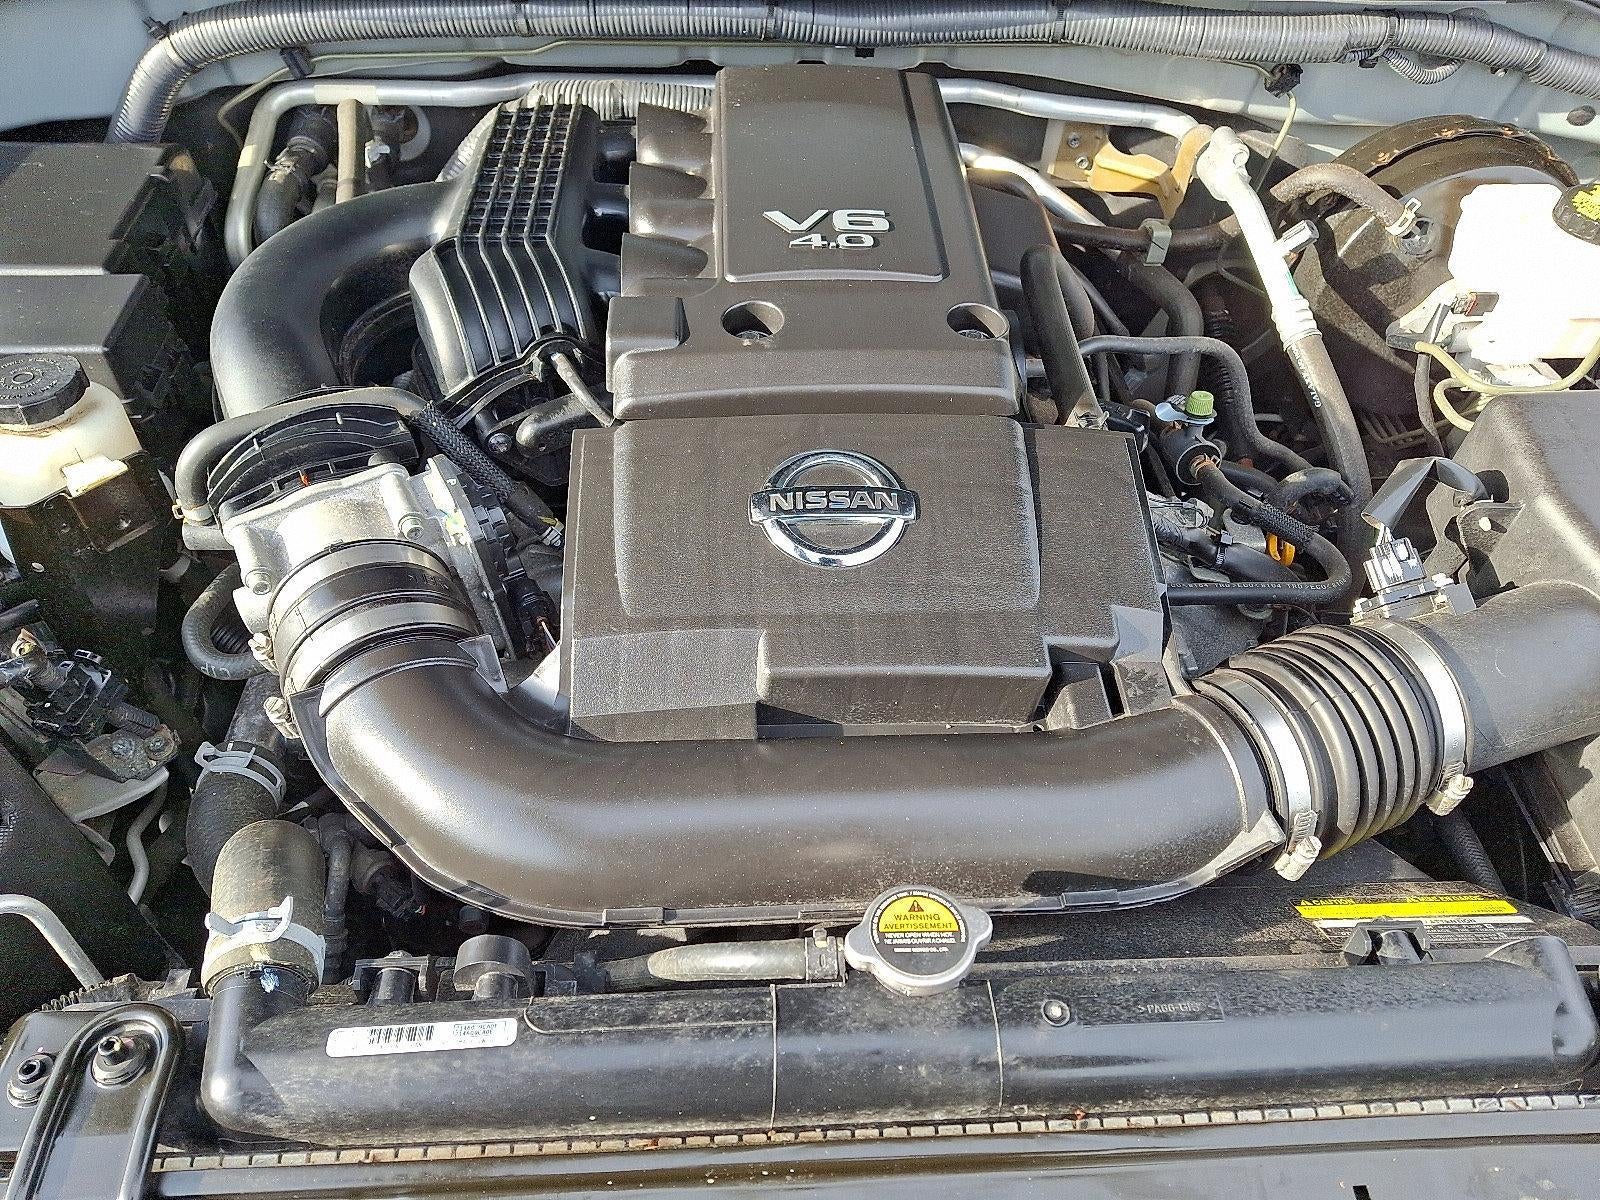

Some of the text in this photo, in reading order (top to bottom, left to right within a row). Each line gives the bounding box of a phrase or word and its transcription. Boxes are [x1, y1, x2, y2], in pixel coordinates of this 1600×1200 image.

[762, 208, 891, 234] V6
[788, 232, 875, 250] 4.0
[769, 490, 899, 512] NISSAN
[1312, 898, 1356, 906] CAUTION
[893, 913, 940, 921] WARNING
[884, 922, 953, 930] AVERTISSEMENT
